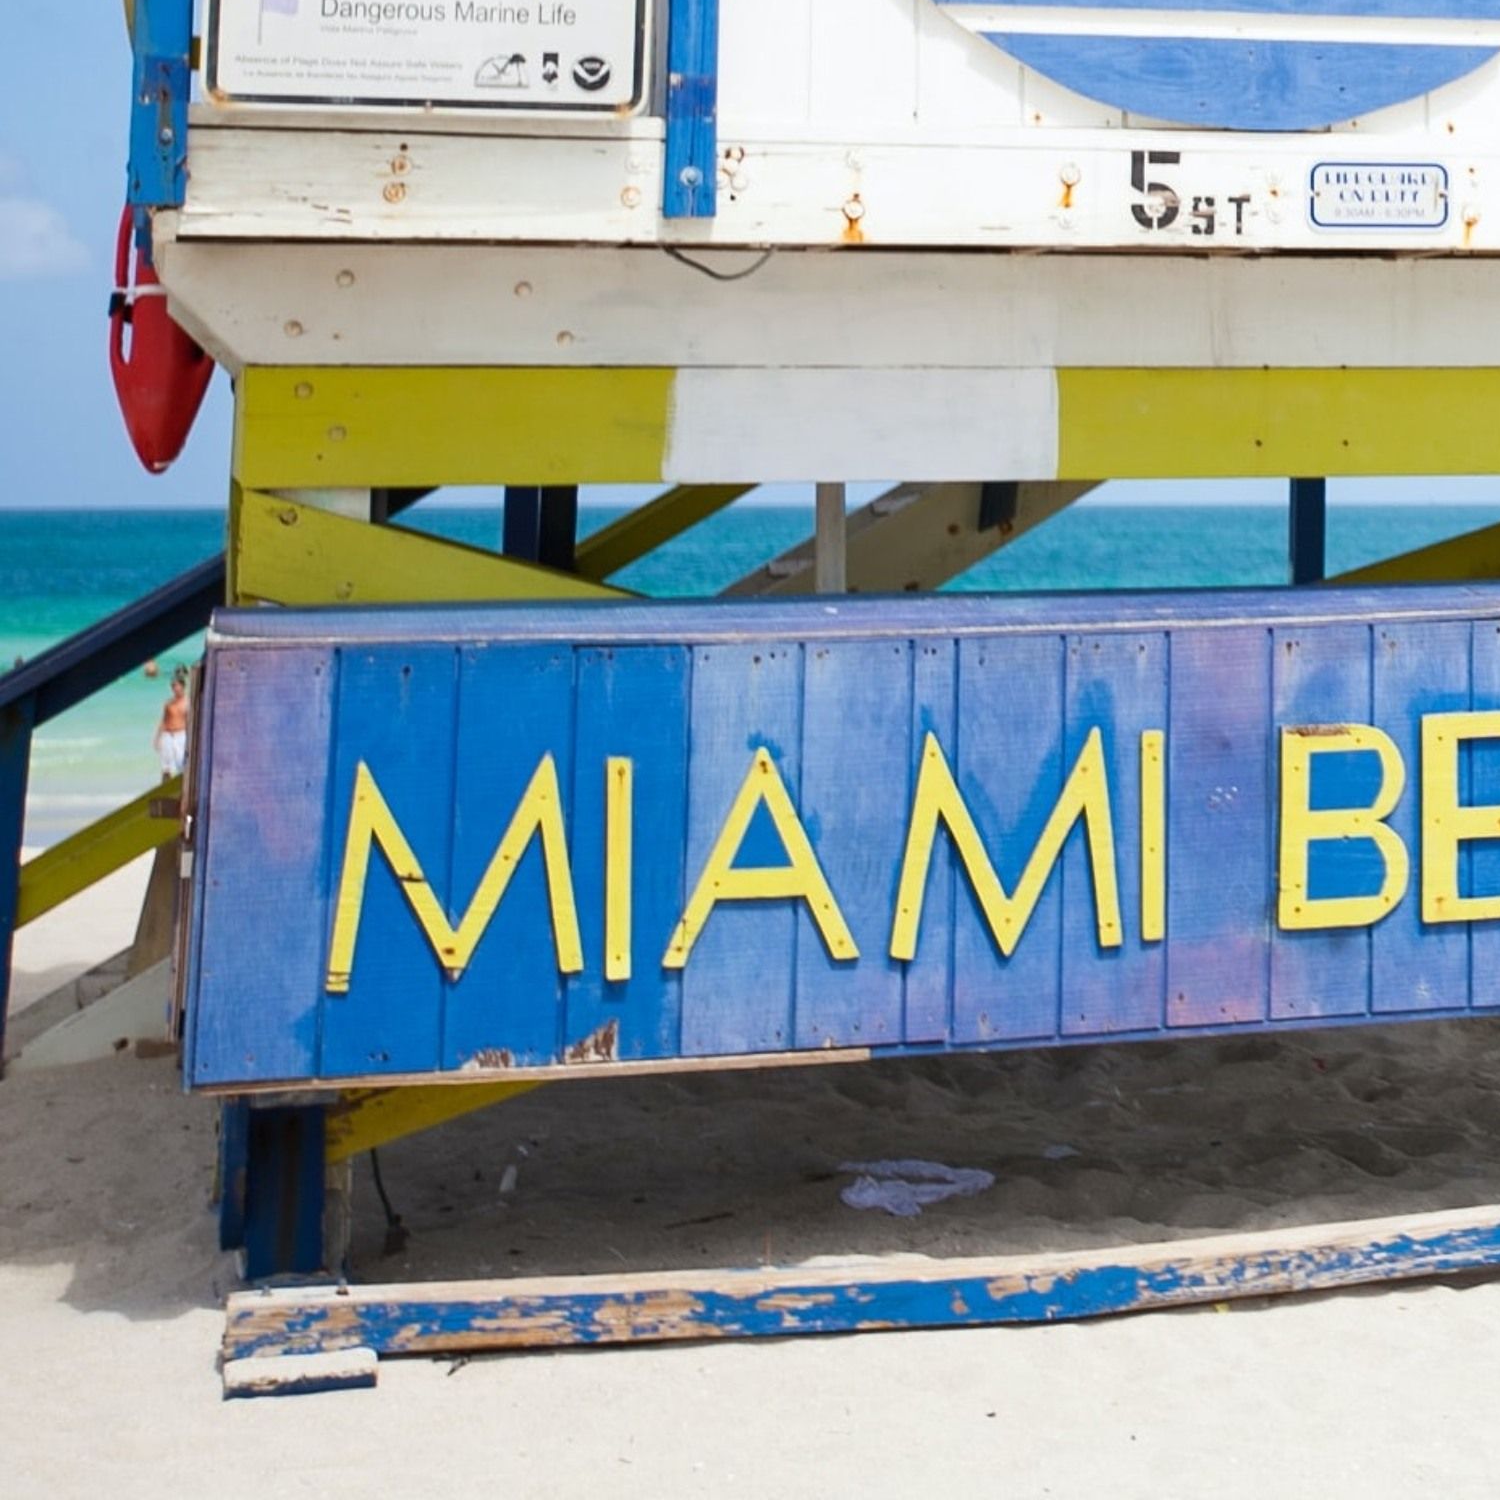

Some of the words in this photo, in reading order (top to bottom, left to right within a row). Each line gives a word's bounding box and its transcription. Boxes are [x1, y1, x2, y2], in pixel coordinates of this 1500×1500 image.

[455, 0, 529, 25] Marine
[538, 2, 577, 27] Life
[1131, 150, 1182, 230] 5
[1192, 194, 1251, 235] ST
[323, 725, 1167, 996] MIAMI
